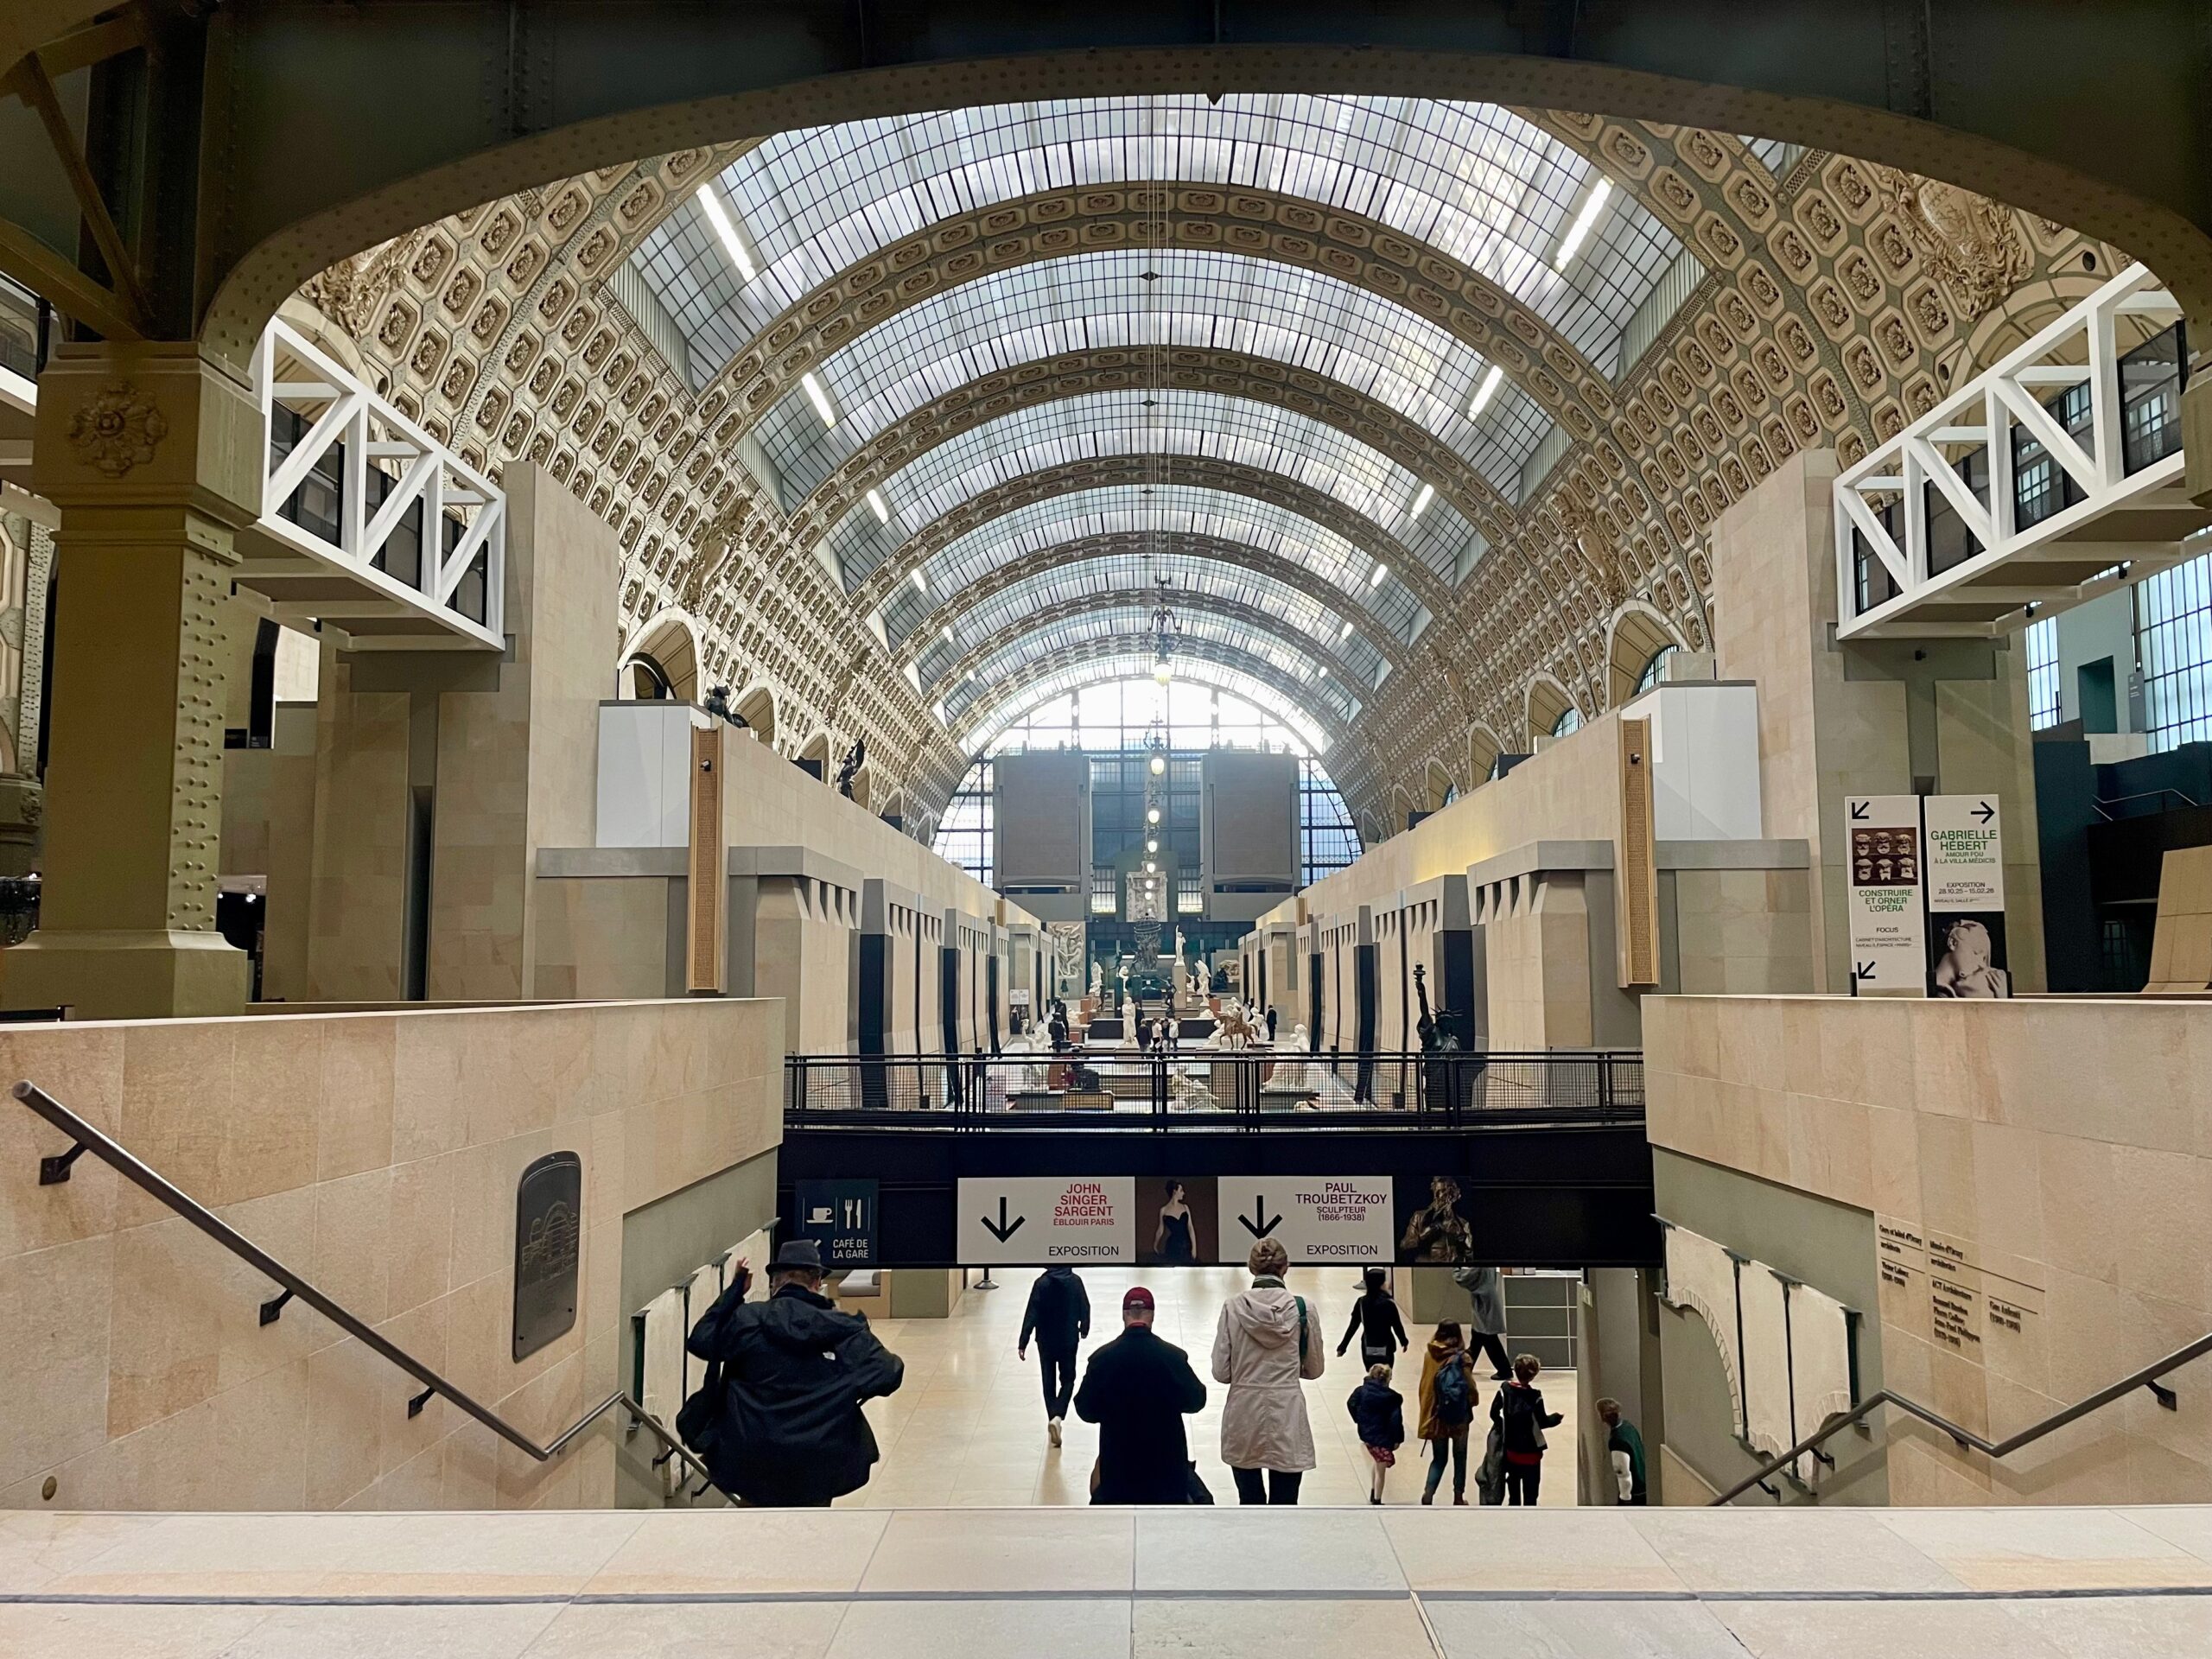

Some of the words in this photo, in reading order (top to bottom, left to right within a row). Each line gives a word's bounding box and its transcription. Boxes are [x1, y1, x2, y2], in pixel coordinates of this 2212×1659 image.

[1931, 830, 1997, 840] GABRIELLE
[1940, 838, 1987, 850] HÉBERT
[1870, 903, 1904, 912] L'OPÉRA
[1066, 1184, 1101, 1194] JOHN
[1325, 1183, 1357, 1193] PAUL
[1061, 1195, 1107, 1205] SINGER
[1296, 1194, 1387, 1205] TROUBETZKOY
[1054, 1206, 1113, 1217] SARGENT
[1053, 1217, 1089, 1226] ÉBLOUIR
[833, 1237, 854, 1249] CAFÉ
[856, 1239, 868, 1249] DE
[833, 1249, 843, 1258] LA
[846, 1249, 868, 1258] GARE
[1049, 1246, 1119, 1256] EXPOSITION
[1306, 1245, 1377, 1255] EXPOSITION
